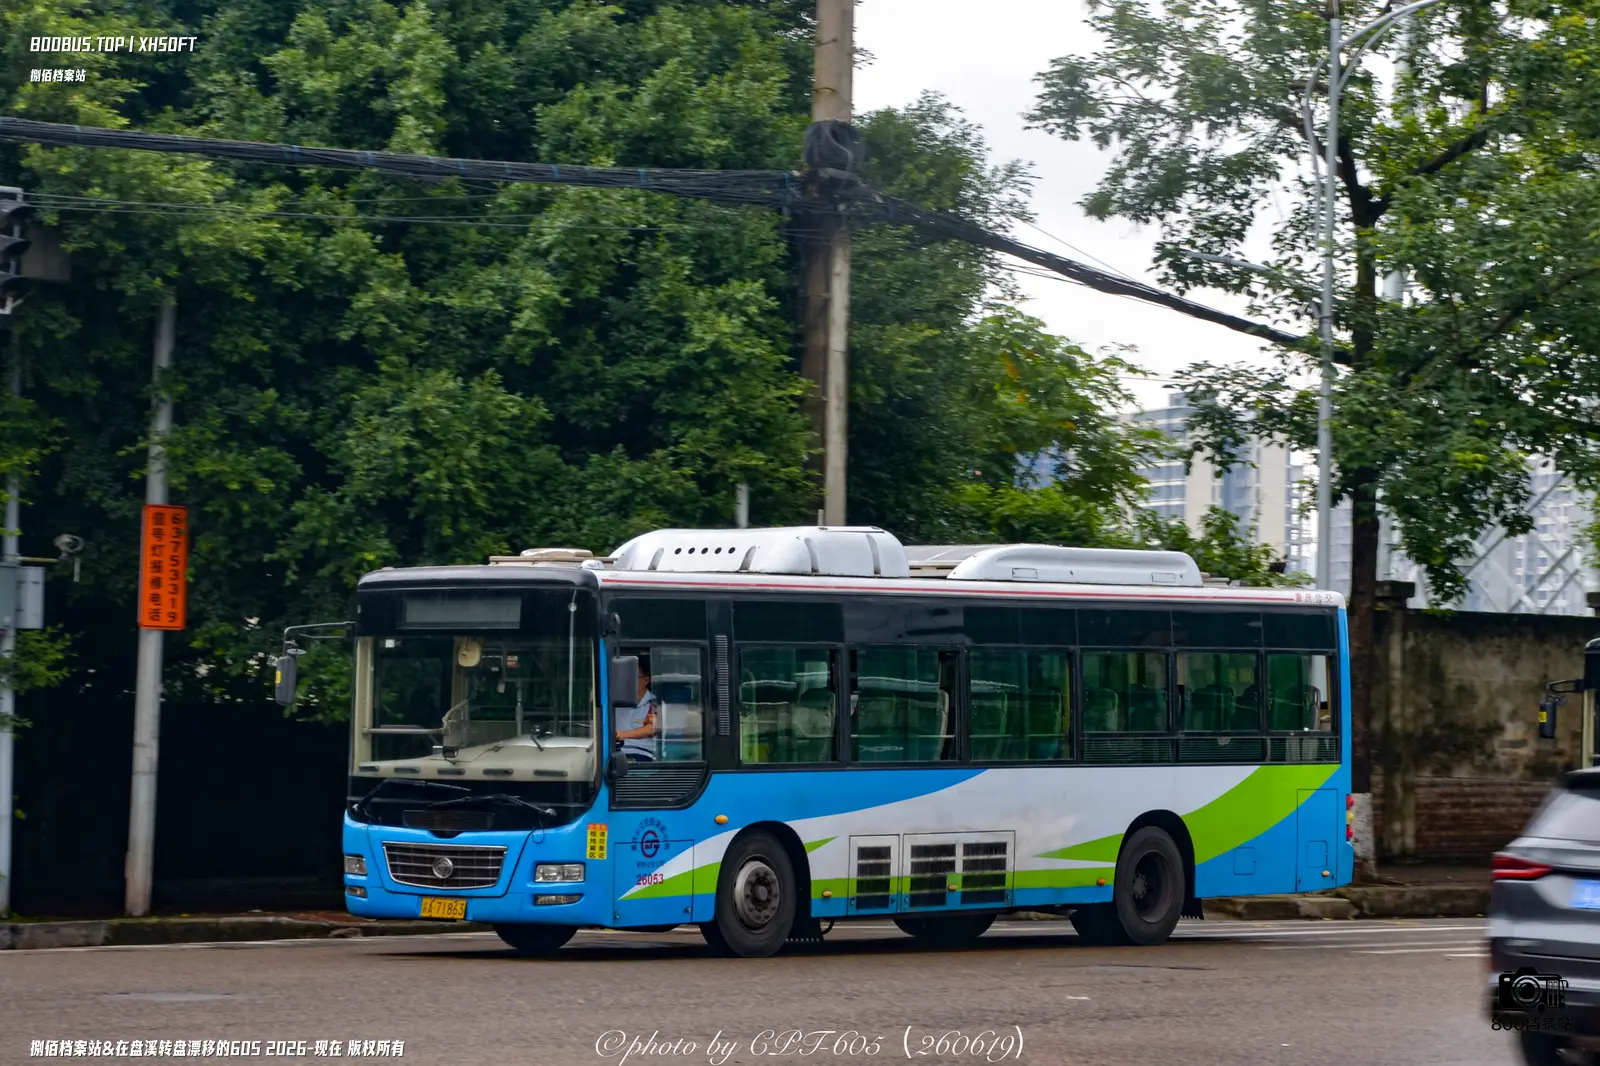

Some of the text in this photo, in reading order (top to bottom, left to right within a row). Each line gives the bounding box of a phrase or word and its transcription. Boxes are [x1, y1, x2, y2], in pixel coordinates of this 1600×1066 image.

[166, 512, 183, 623] 63753319
[1295, 593, 1332, 604] 重庆公交
[636, 873, 664, 885] 26053
